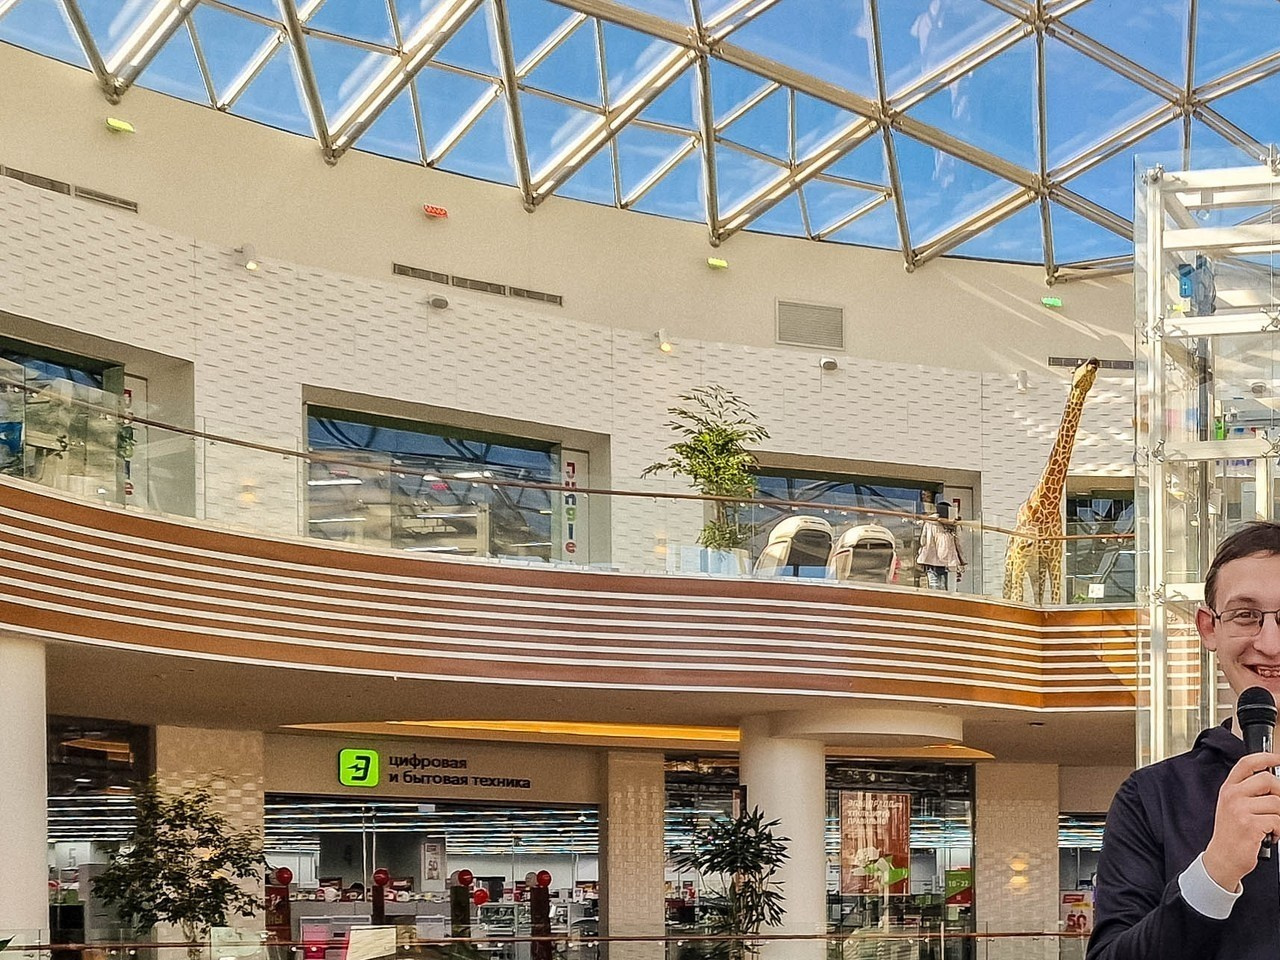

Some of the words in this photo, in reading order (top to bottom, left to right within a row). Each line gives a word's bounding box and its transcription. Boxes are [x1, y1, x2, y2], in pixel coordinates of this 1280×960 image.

[389, 754, 467, 770] цифровая
[389, 773, 399, 782] и
[403, 771, 469, 785] бытовая
[472, 776, 531, 788] техника
